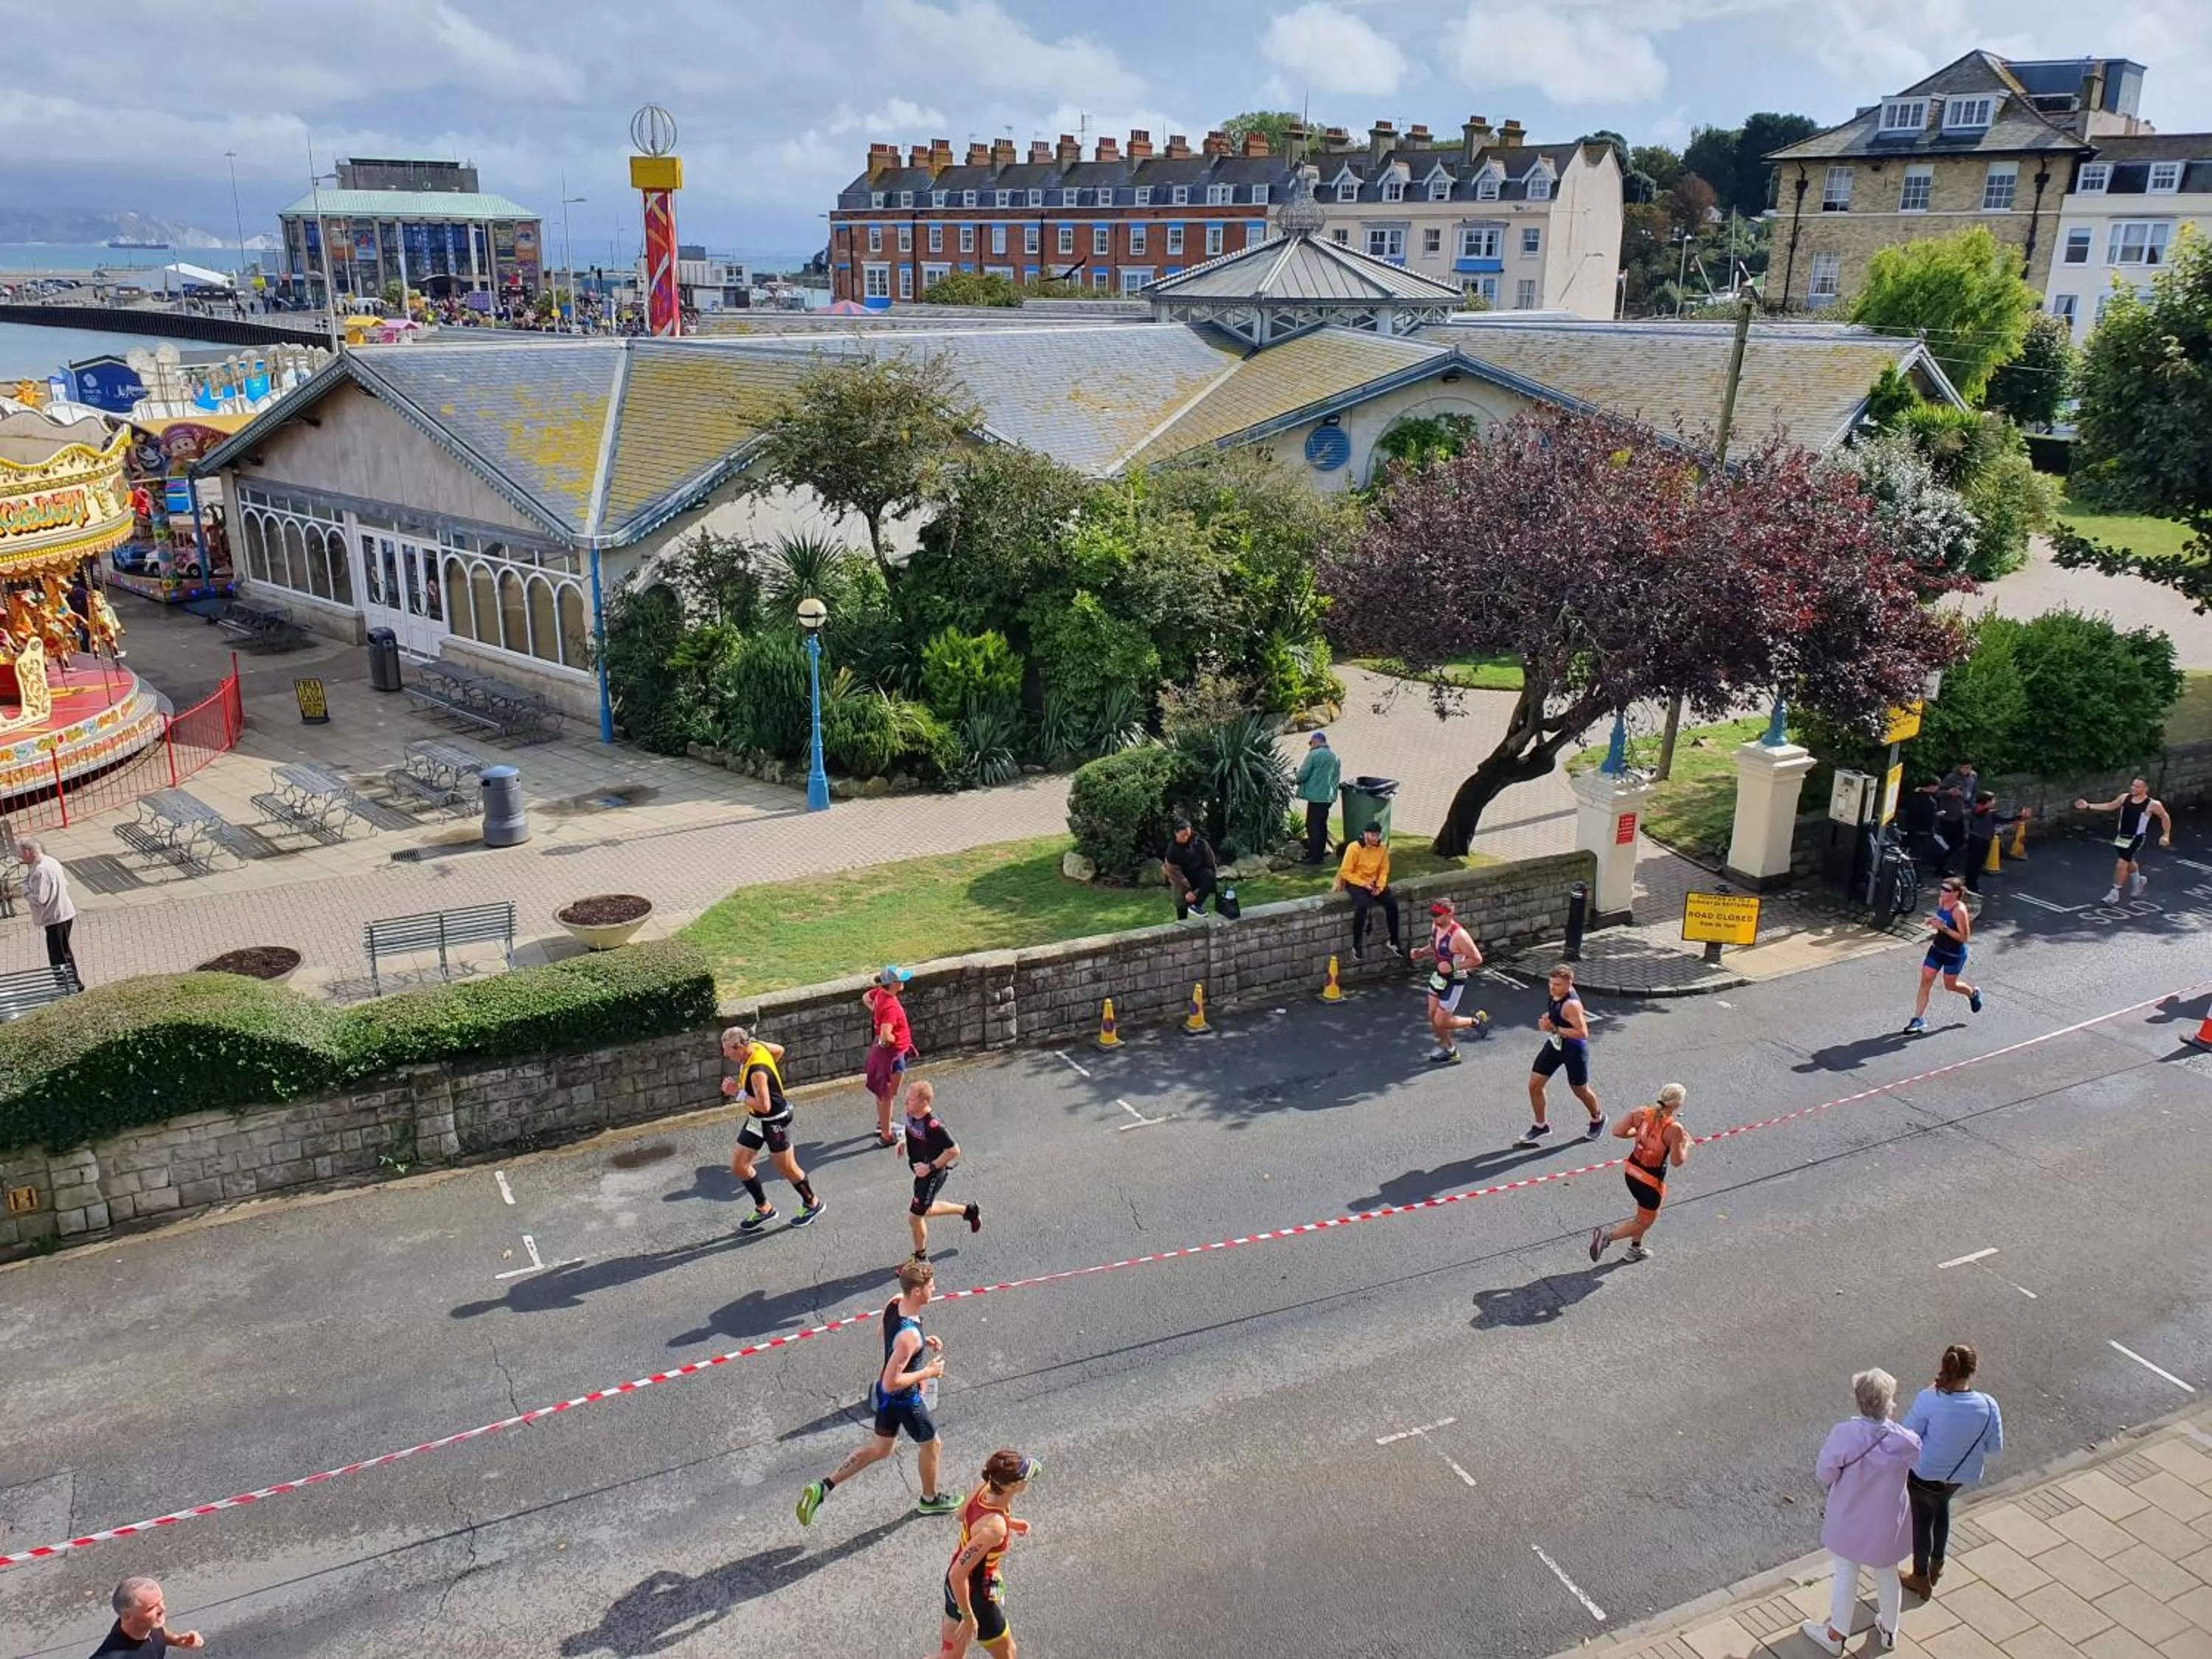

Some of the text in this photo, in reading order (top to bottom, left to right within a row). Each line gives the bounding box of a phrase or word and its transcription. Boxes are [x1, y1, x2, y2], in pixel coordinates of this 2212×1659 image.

[1688, 911, 1753, 922] ROAD CLOSED
[2077, 900, 2164, 925] SOLO
